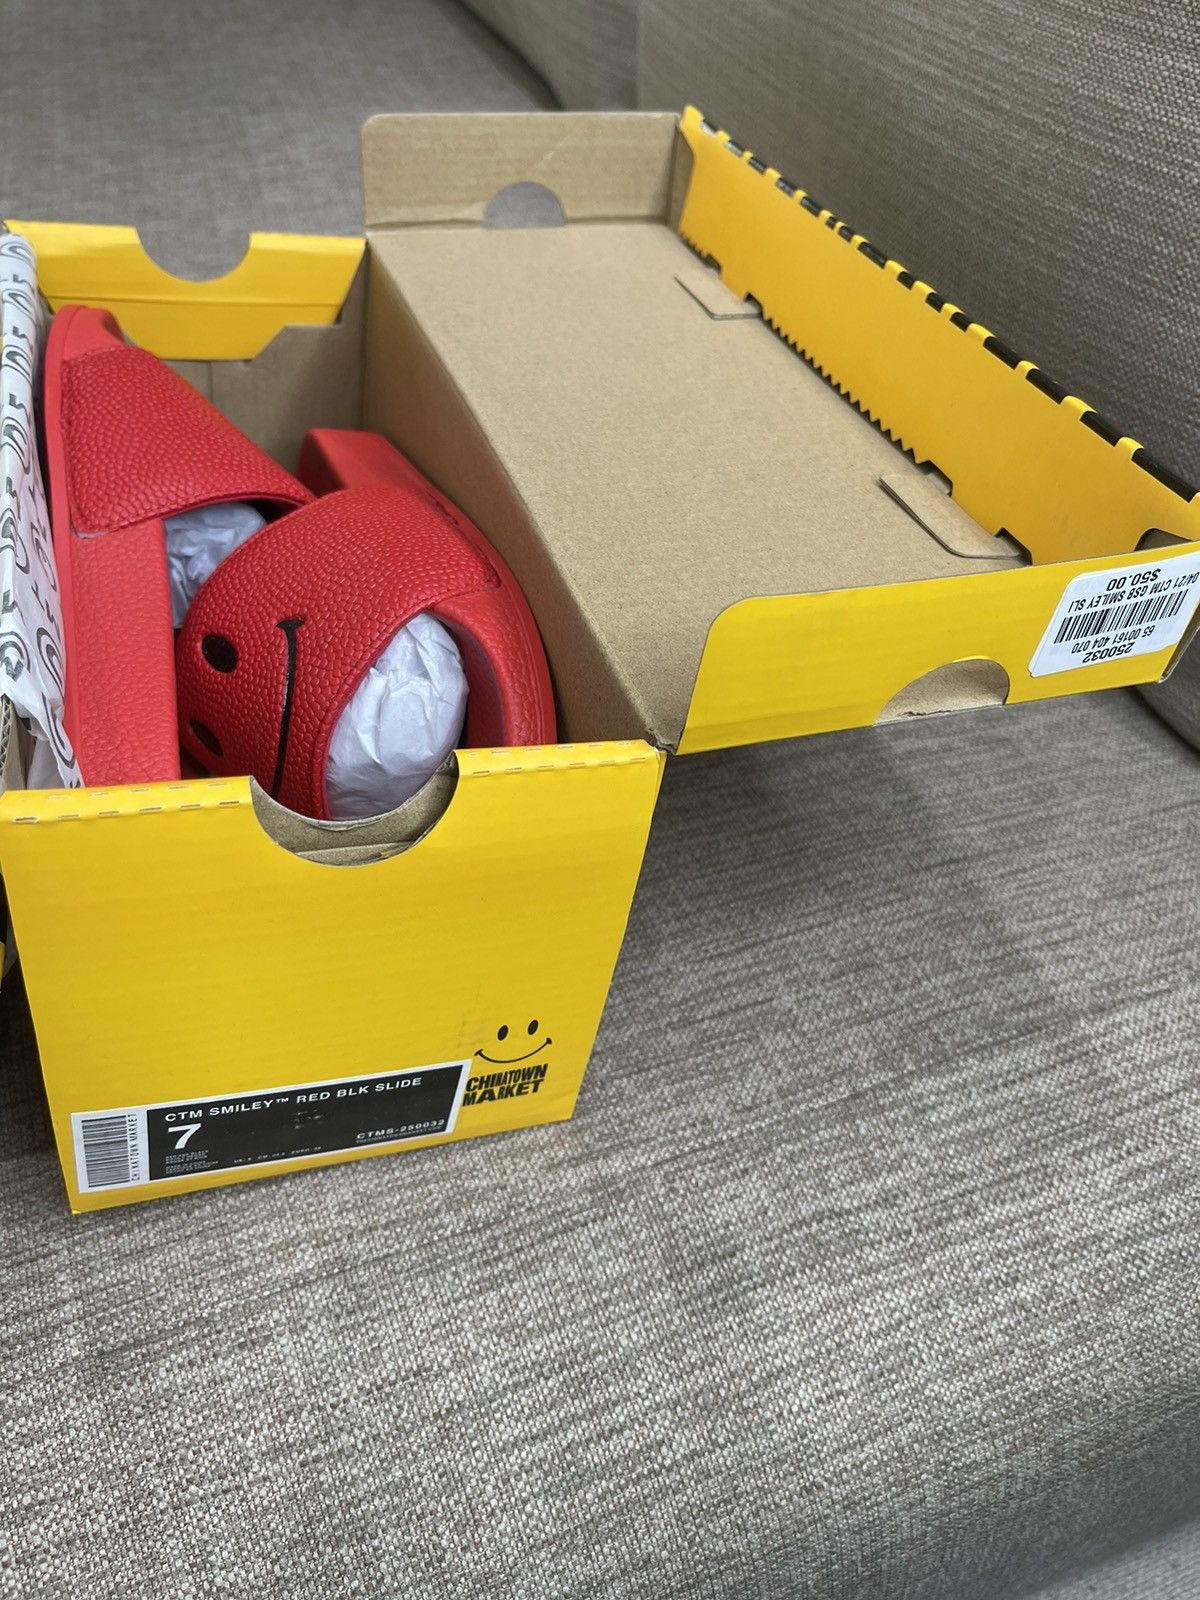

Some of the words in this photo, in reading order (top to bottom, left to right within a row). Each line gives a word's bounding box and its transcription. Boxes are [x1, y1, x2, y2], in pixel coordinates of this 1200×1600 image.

[1106, 568, 1161, 592] $50.00
[1152, 579, 1173, 596] CTM
[1174, 571, 1200, 588] 04/21
[1087, 590, 1126, 610] SMILEY
[1127, 585, 1149, 601] GSB
[1067, 599, 1086, 614] SLI
[1113, 628, 1142, 644] 00161
[1142, 625, 1156, 637] 65
[1071, 642, 1091, 654] 070
[1093, 636, 1110, 649] 404
[1082, 641, 1136, 664] 250032
[465, 1063, 549, 1092] CHINATOWN
[164, 1109, 203, 1122] CTM
[296, 1091, 331, 1104] RED
[336, 1085, 369, 1098] BLK
[375, 1077, 422, 1092] SLIDE
[462, 1079, 544, 1107] MARKET
[167, 1122, 202, 1150] 7
[356, 1118, 445, 1140] CTMS-250032
